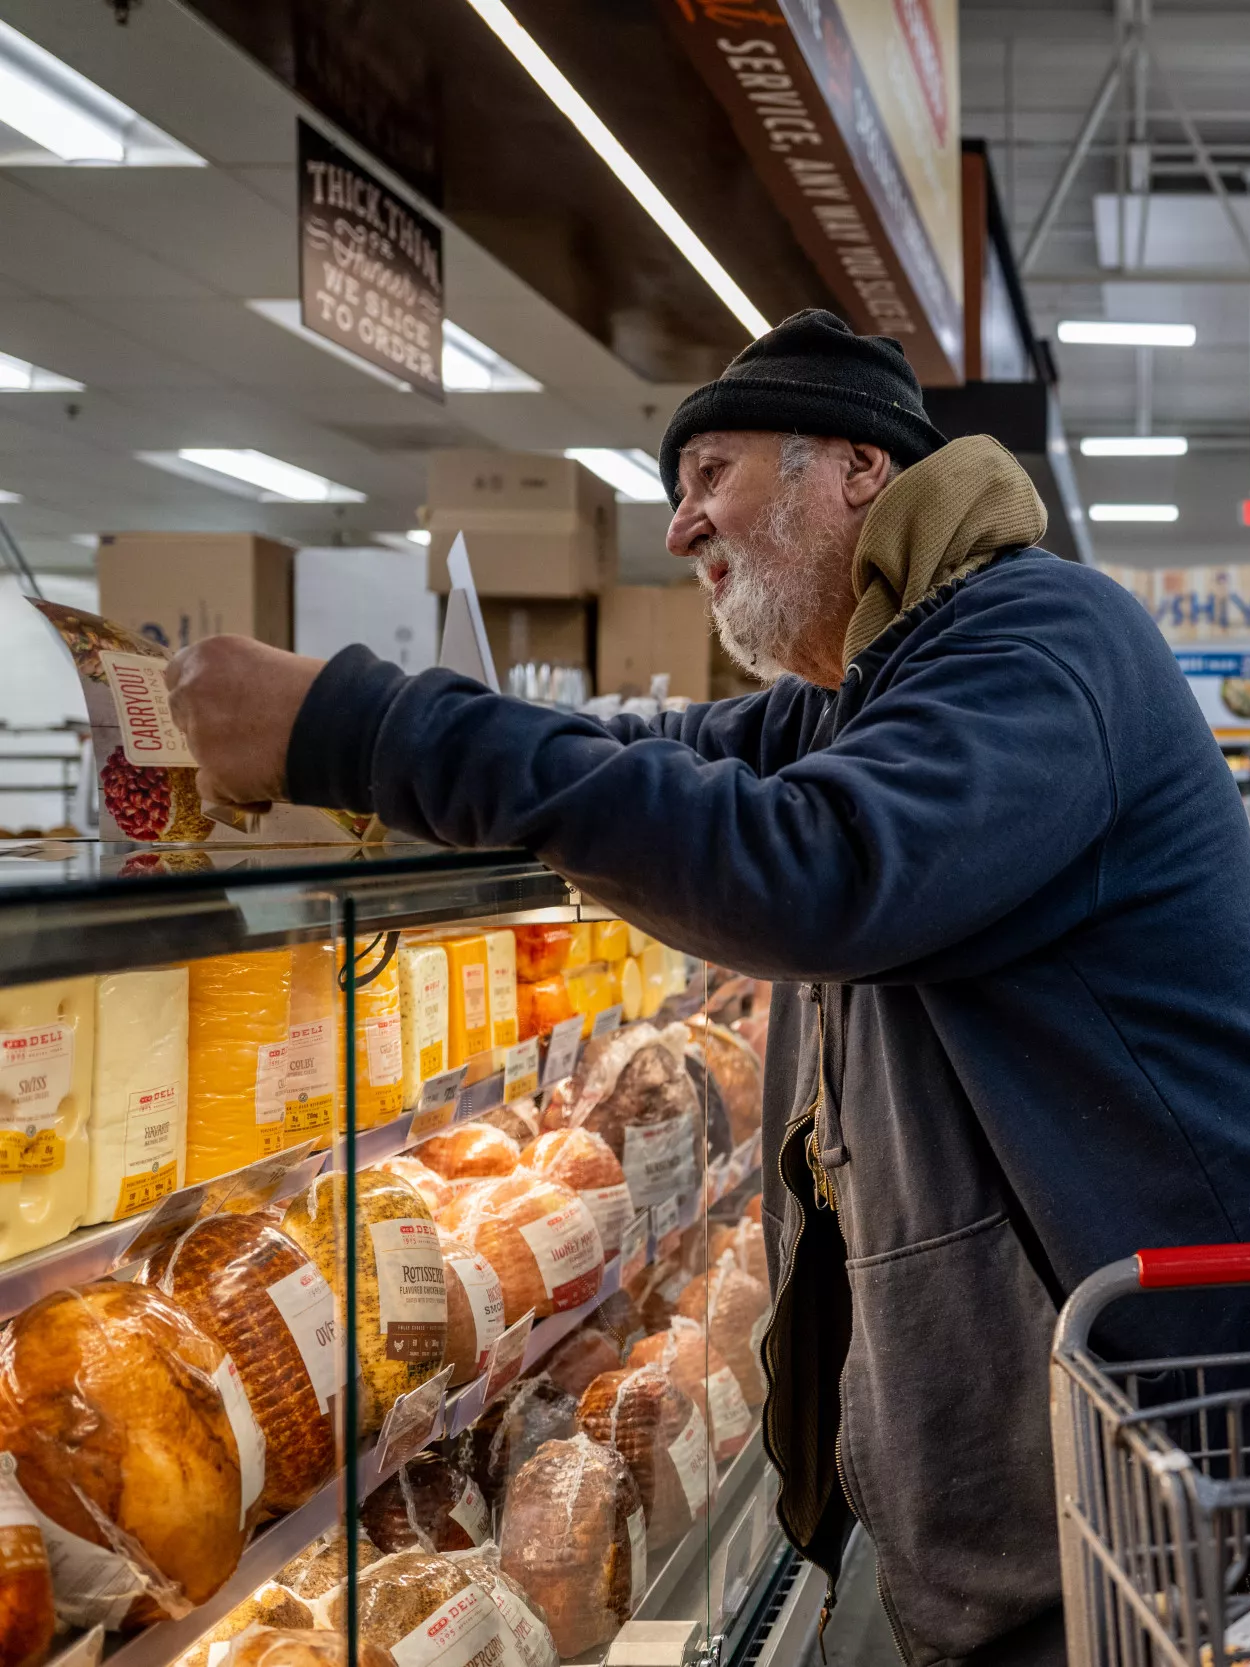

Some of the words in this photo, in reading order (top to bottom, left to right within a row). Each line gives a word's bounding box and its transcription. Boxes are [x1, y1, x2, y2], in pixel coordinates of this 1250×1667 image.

[717, 38, 822, 152] SERVICE,
[384, 200, 443, 294] THIN
[316, 289, 354, 332] TO
[322, 261, 360, 307] WE
[365, 289, 431, 349] SLICE
[112, 662, 164, 752] CARRYOUT
[142, 667, 177, 752] CATERING
[29, 1030, 63, 1047] DELI
[291, 1025, 323, 1039] DELI
[289, 1057, 315, 1071] COLBY
[18, 1075, 48, 1095] SWISS
[153, 1087, 175, 1101] DELI
[448, 1593, 478, 1619] DELI
